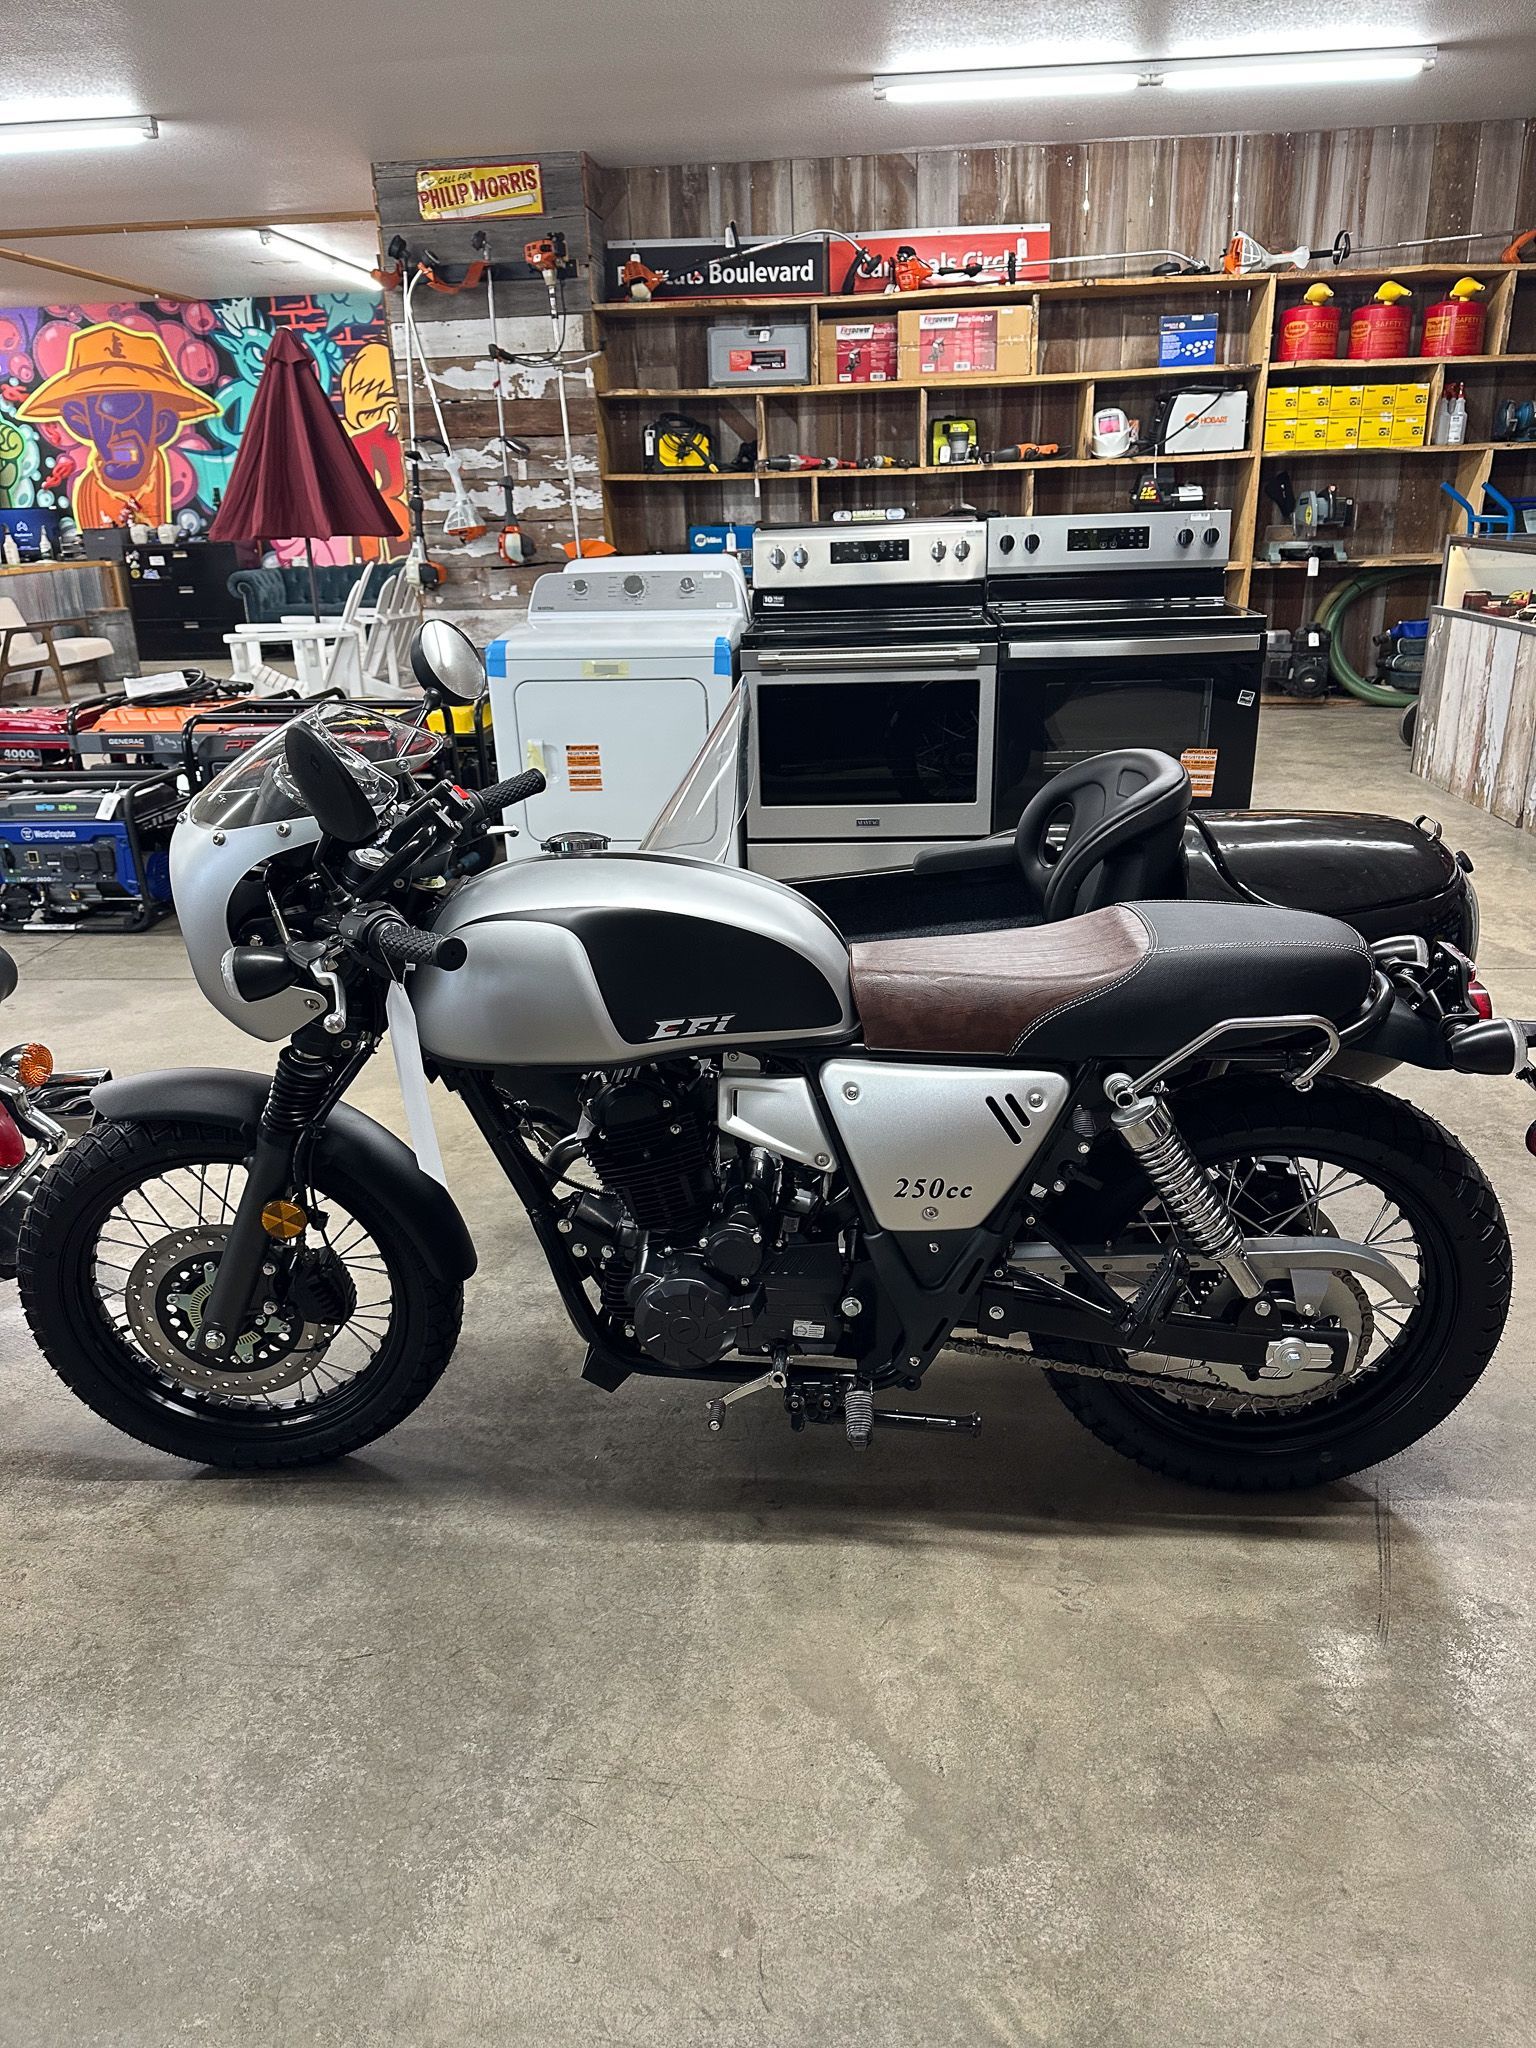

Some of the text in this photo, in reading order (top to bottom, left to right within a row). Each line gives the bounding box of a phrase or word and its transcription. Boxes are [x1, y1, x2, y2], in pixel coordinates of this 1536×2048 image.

[438, 171, 473, 184] CALL FOR
[419, 168, 538, 210] PHILIP MORRIS
[709, 258, 814, 284] Boulevard
[1200, 415, 1228, 424] HOBART
[764, 595, 773, 603] 10
[3, 749, 34, 759] 4000
[893, 1177, 973, 1199] 250cc
